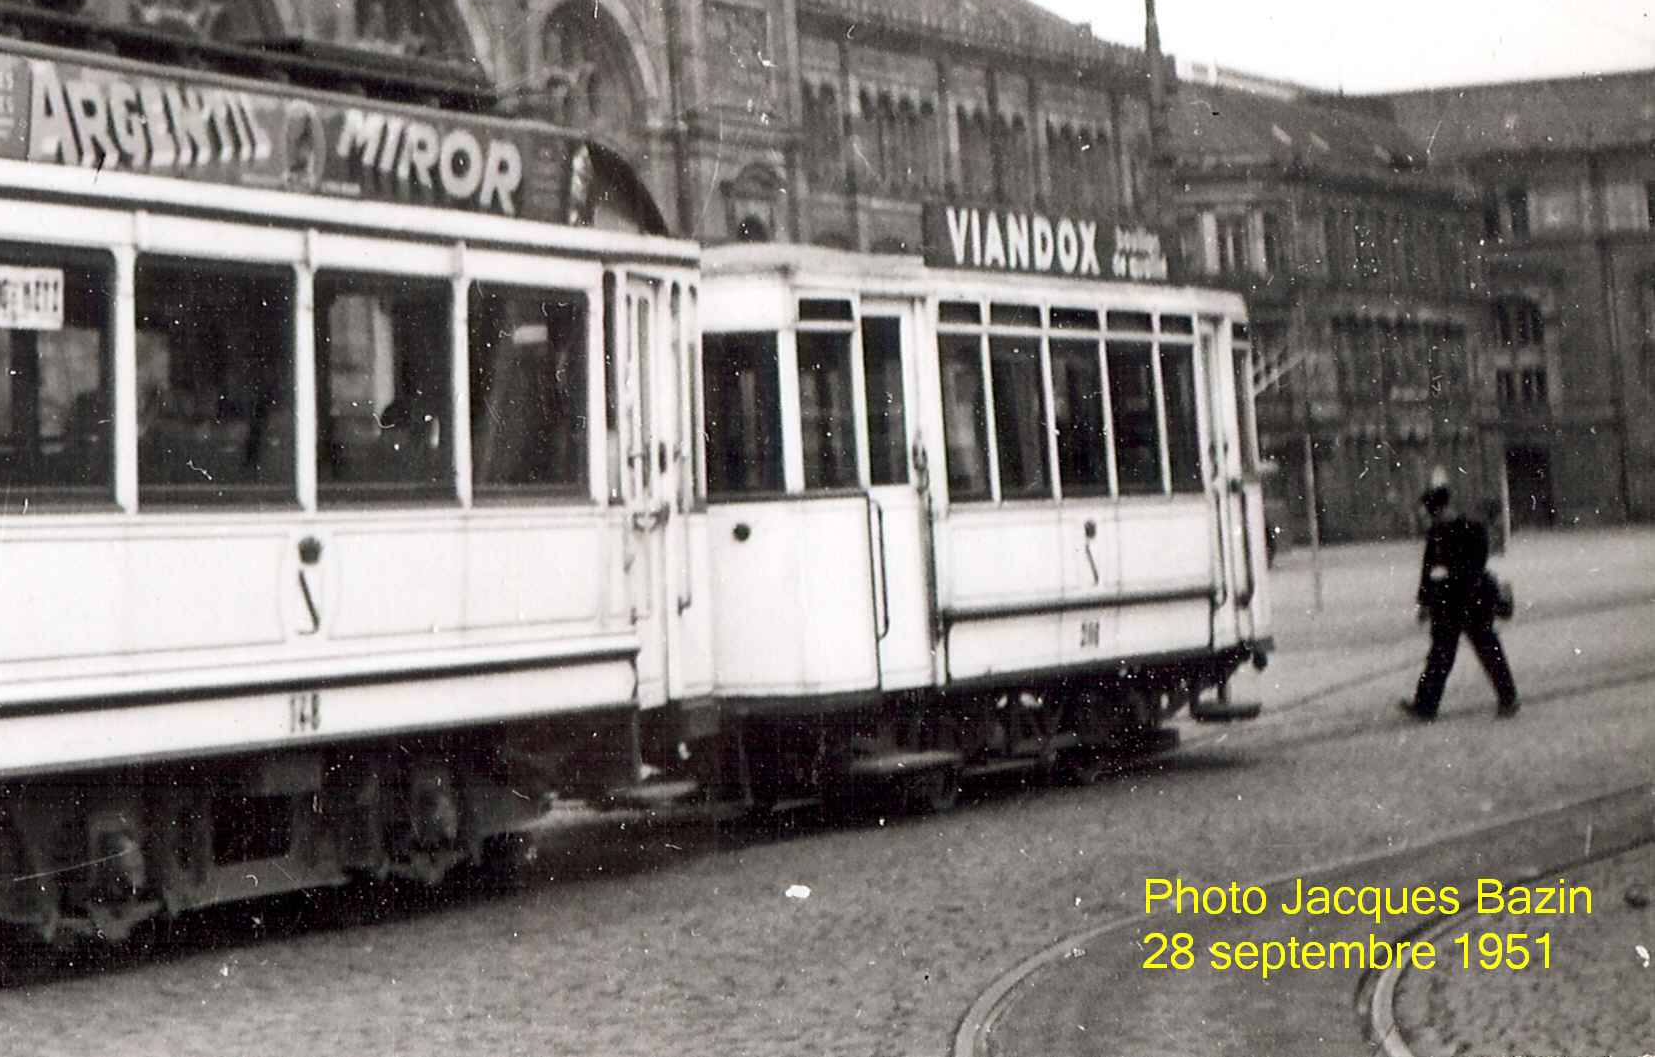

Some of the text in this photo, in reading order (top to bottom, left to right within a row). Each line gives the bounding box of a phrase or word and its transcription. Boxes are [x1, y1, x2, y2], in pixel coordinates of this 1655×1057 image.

[336, 107, 523, 216] MIROR
[945, 205, 1101, 276] VIANDOX
[289, 692, 322, 734] 148
